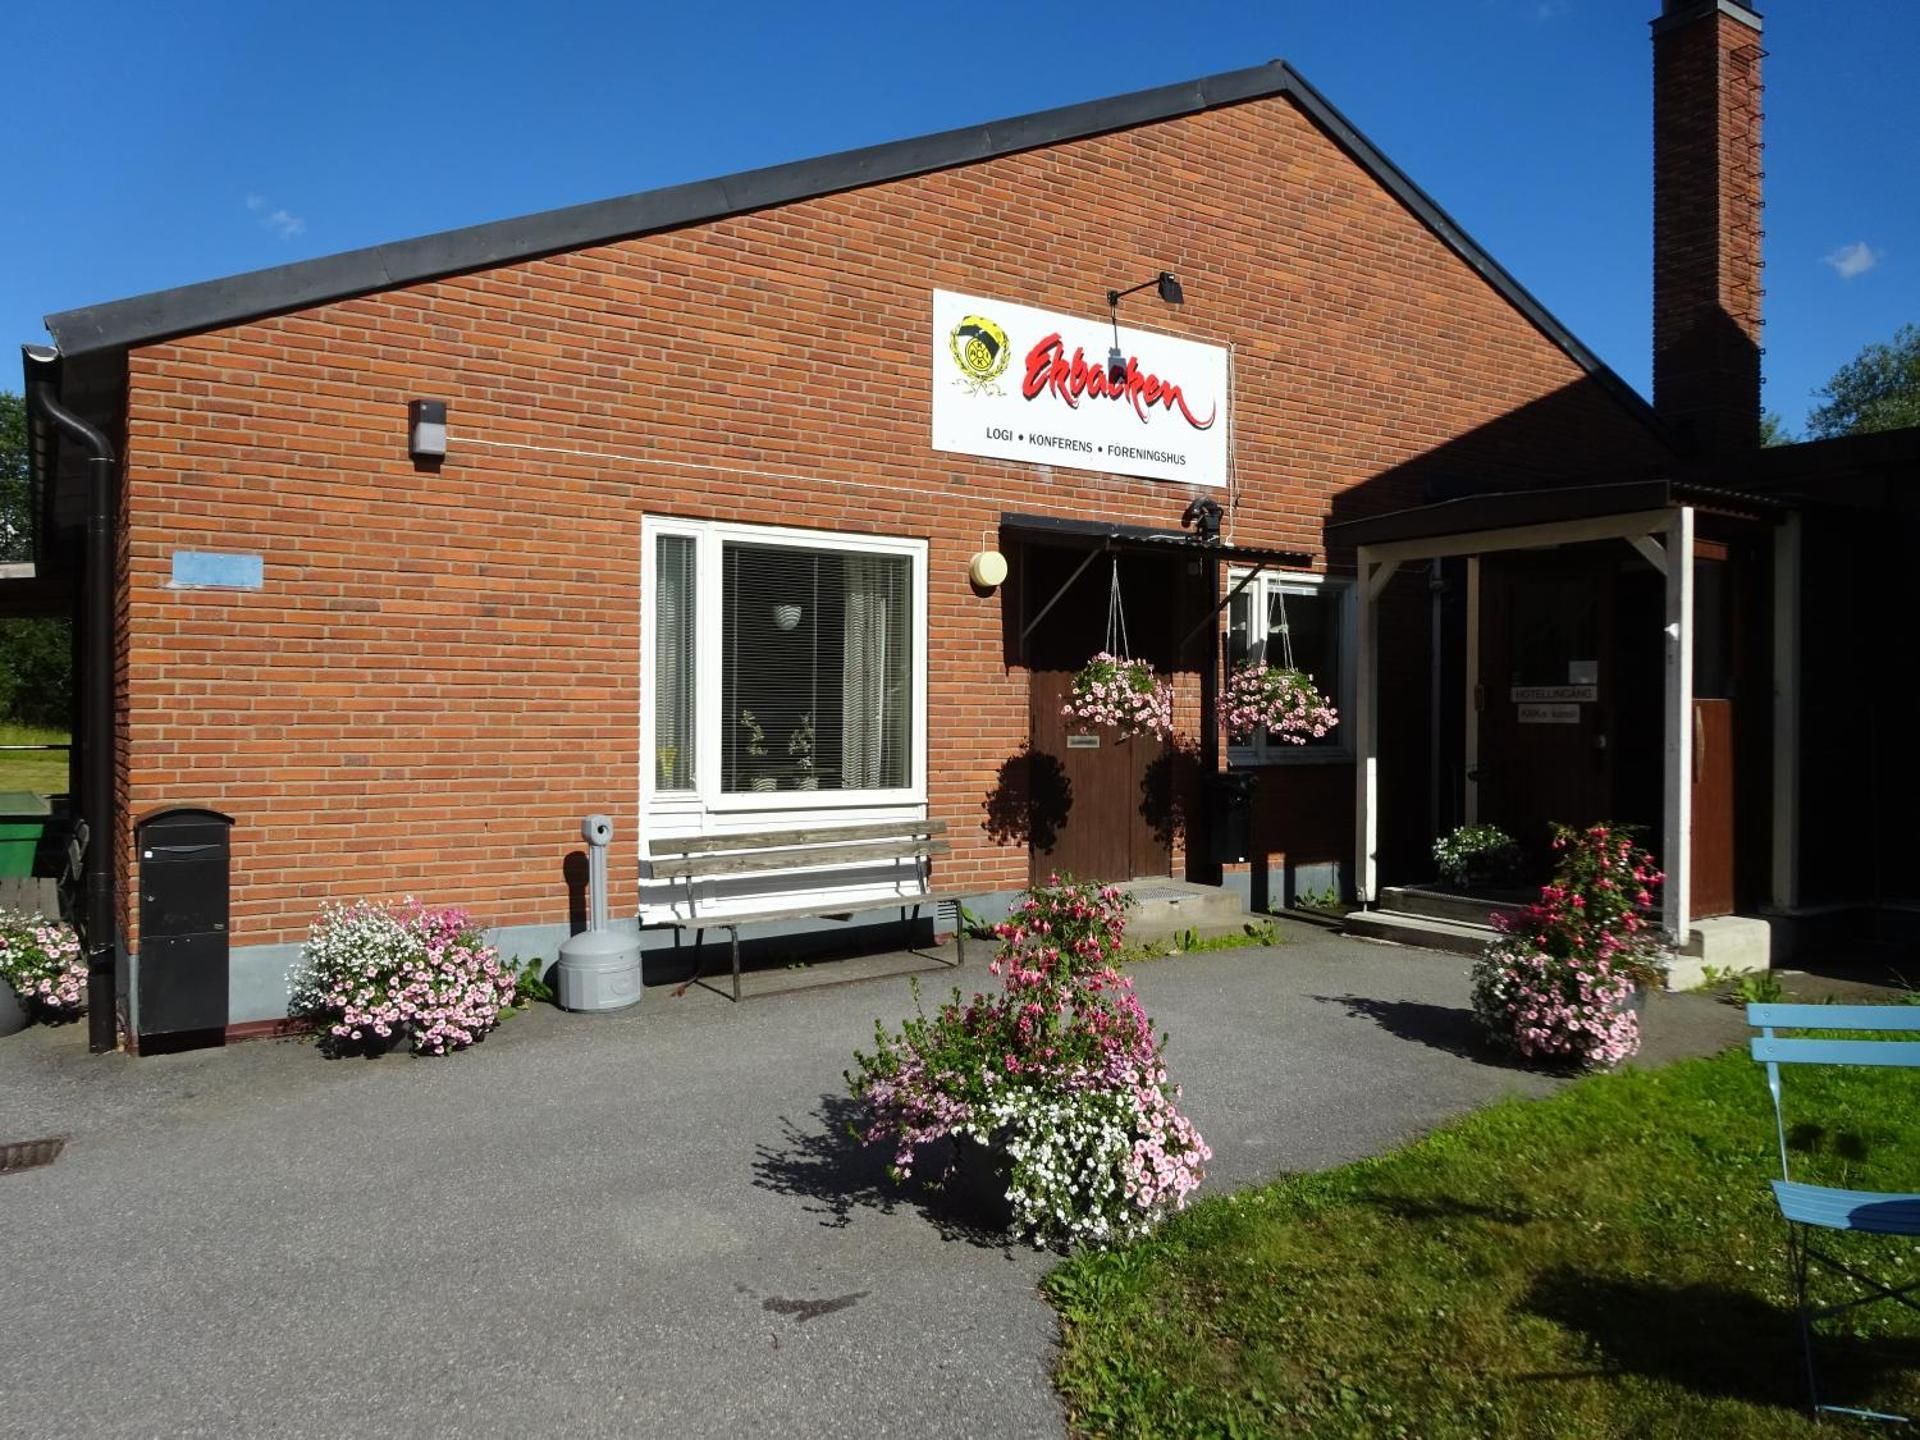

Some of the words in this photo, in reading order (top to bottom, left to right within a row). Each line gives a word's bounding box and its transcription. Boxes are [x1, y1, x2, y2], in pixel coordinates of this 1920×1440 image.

[1022, 332, 1216, 431] Ekbacken
[986, 427, 1013, 441] LOGI
[1028, 433, 1093, 453] KONFERENS
